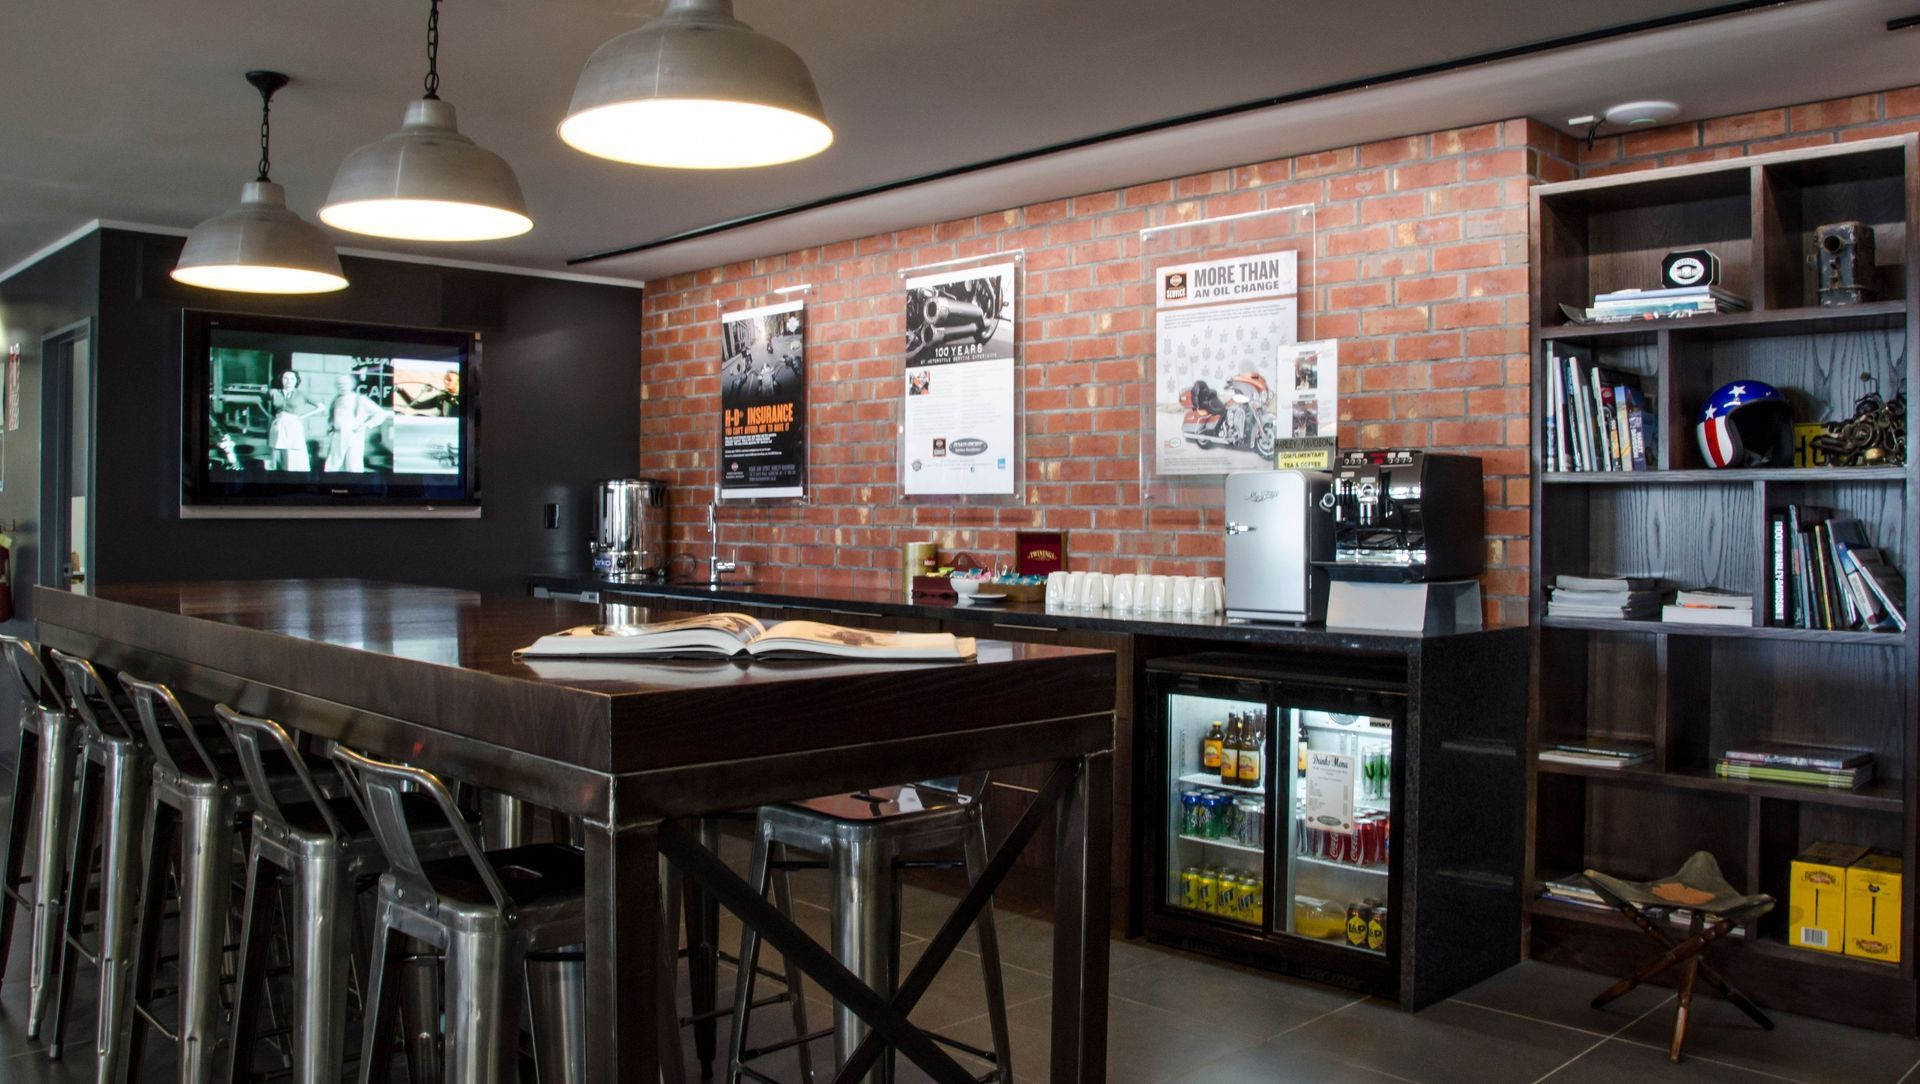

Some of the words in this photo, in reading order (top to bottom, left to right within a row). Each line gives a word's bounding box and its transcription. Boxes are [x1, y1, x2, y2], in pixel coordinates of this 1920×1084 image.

[1194, 265, 1235, 288] MORE
[1240, 260, 1279, 282] THAN
[1195, 289, 1210, 298] AN
[1213, 287, 1230, 296] OIL
[1234, 280, 1280, 294] CHANGE
[935, 347, 949, 357] 100
[951, 343, 983, 356] YEARS
[747, 402, 794, 425] INSURANCE
[1313, 754, 1330, 766] Drinks
[1332, 756, 1348, 768] Menu
